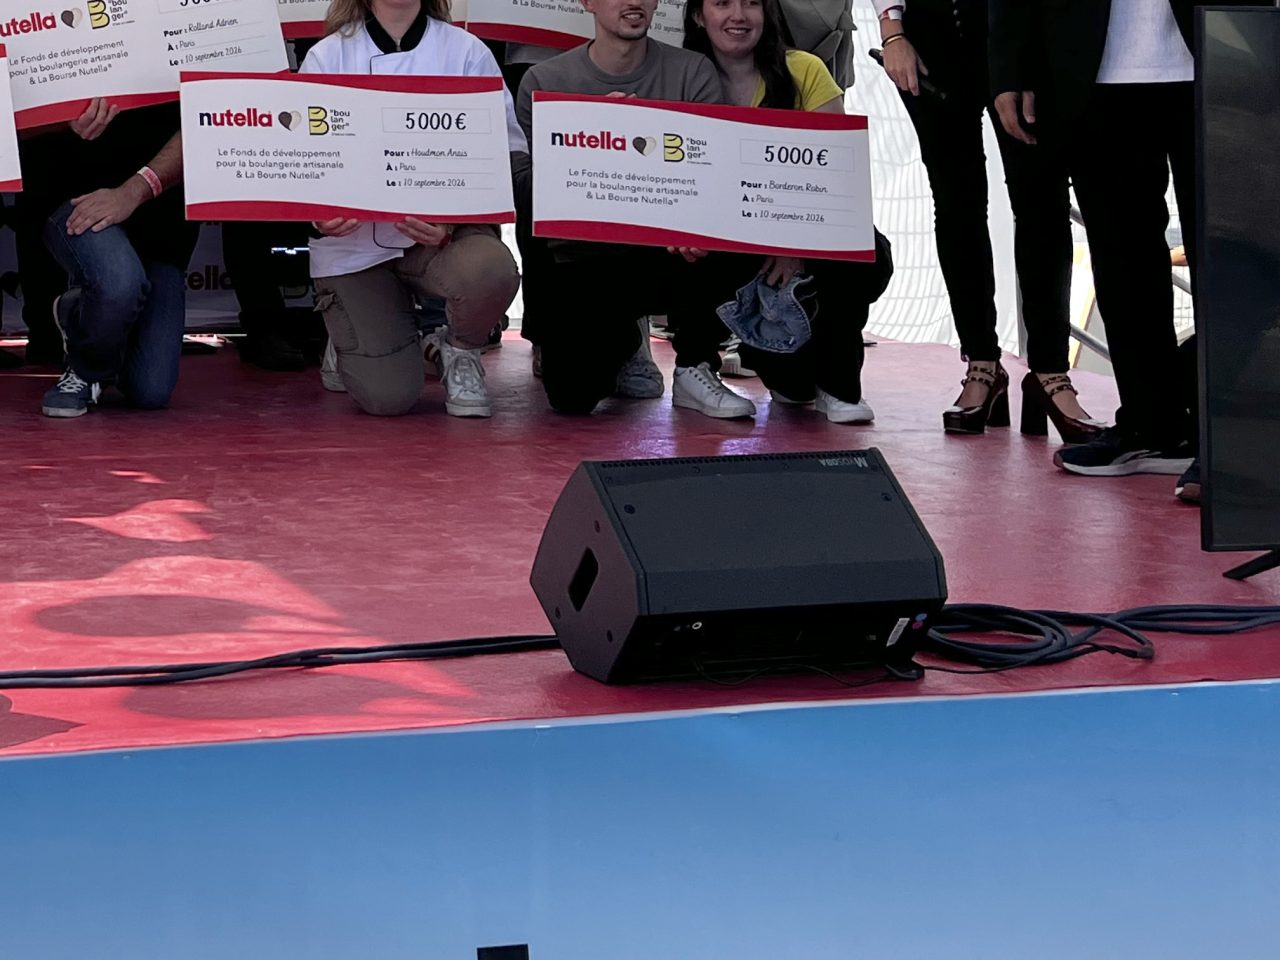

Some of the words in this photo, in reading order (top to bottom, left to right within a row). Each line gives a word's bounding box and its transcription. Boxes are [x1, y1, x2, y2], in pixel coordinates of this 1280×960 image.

[164, 29, 182, 37] Pour
[38, 74, 47, 84] La
[49, 71, 77, 82] Bourse
[218, 148, 228, 156] Le
[230, 148, 257, 157] Fonds
[259, 149, 270, 157] de
[272, 149, 340, 159] développement
[216, 160, 237, 169] pour
[239, 159, 246, 167] la
[249, 159, 301, 170] boulangerie
[302, 160, 344, 169] artisanale
[245, 171, 255, 179] La
[258, 171, 287, 179] Bourse
[741, 180, 762, 189] Pour
[596, 192, 606, 200] La
[608, 193, 638, 203] Bourse
